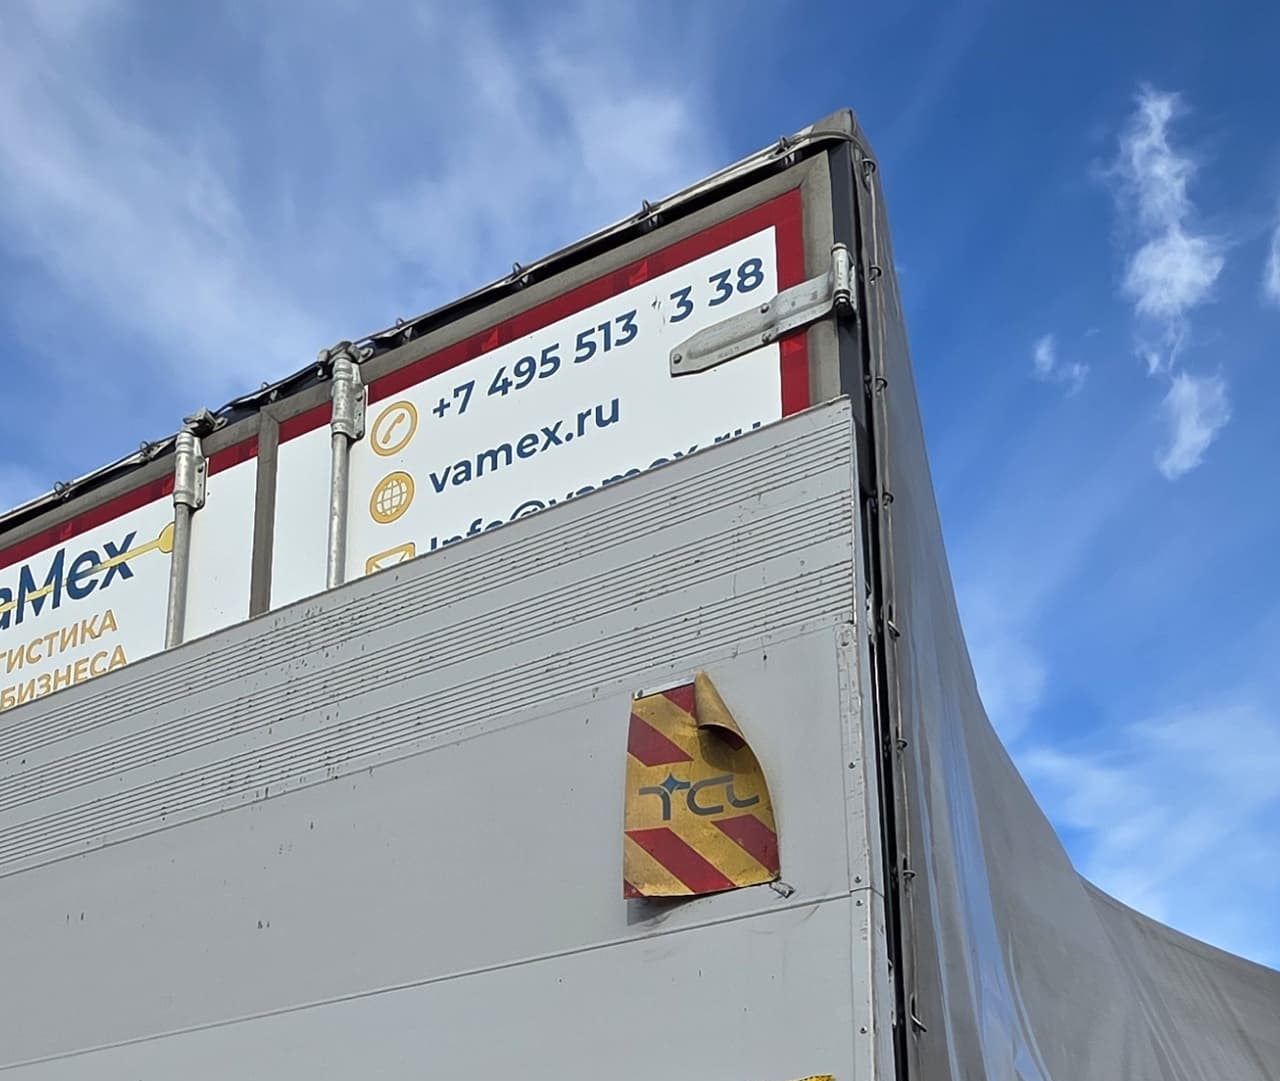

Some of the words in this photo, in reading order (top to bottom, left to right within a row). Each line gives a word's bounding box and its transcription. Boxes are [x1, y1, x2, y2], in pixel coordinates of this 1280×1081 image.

[431, 380, 476, 419] +7
[486, 344, 562, 398] 495
[573, 309, 638, 364] 513
[708, 258, 765, 307] 38
[428, 397, 620, 493] vamex.ru
[0, 645, 128, 713] БИЗНЕСА
